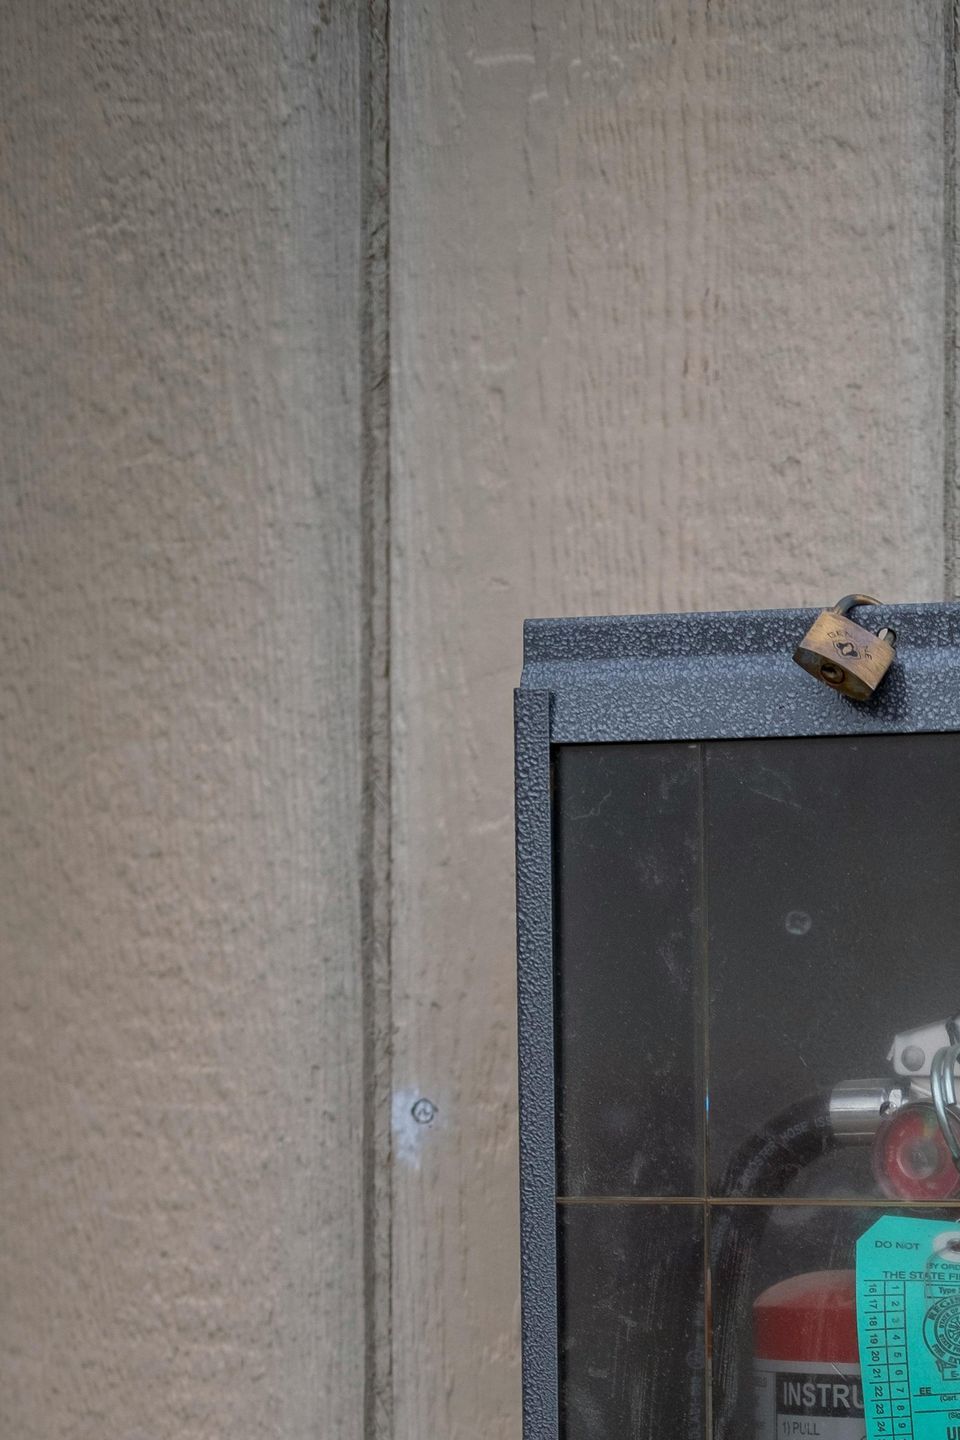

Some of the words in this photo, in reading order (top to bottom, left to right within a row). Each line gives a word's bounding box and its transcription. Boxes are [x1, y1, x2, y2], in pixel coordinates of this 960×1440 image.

[875, 1240, 892, 1249] DO
[895, 1242, 920, 1250] NOT
[882, 1270, 906, 1280] THE
[909, 1271, 945, 1281] STATE
[869, 1284, 877, 1294] 16
[938, 1286, 956, 1295] Type
[869, 1299, 878, 1309] 17
[869, 1316, 878, 1326] 18
[870, 1334, 878, 1344] 19
[871, 1350, 880, 1361] 20
[873, 1368, 881, 1378] 21
[783, 1381, 865, 1409] INSTRU
[875, 1385, 883, 1397] 22
[919, 1386, 932, 1396] EE
[875, 1403, 884, 1415] 23
[793, 1421, 820, 1436] PULL
[878, 1421, 885, 1432] 24
